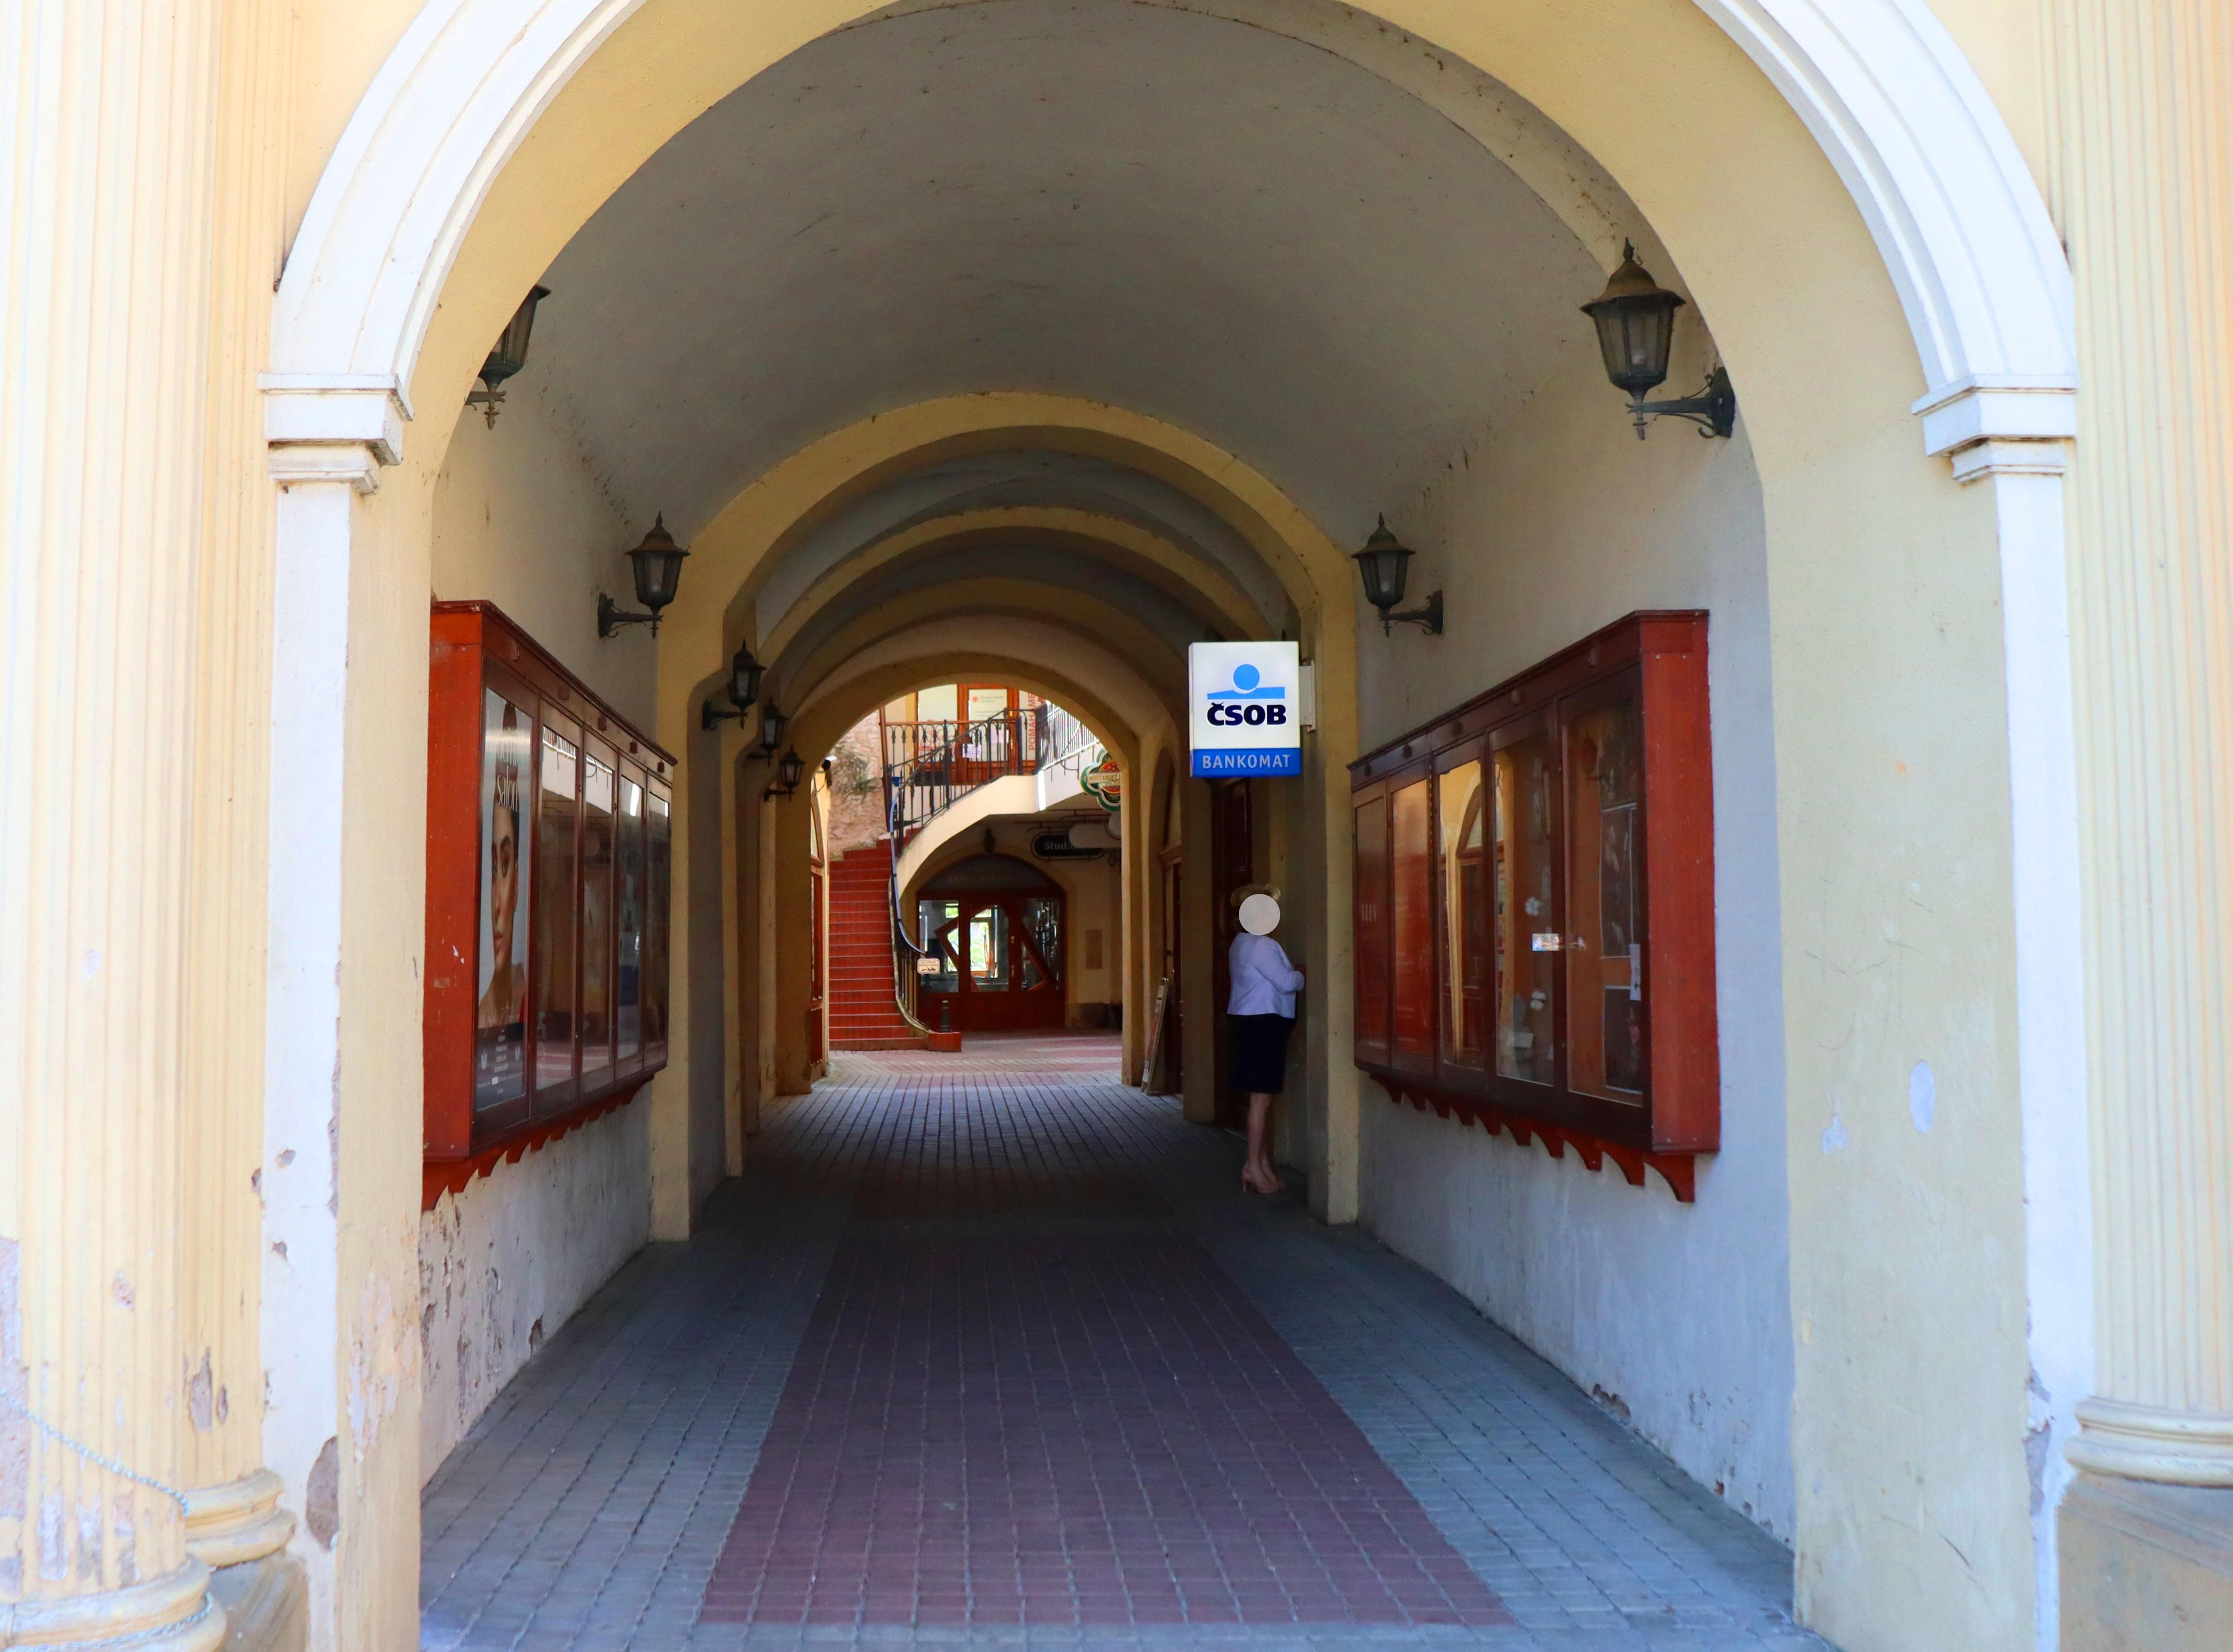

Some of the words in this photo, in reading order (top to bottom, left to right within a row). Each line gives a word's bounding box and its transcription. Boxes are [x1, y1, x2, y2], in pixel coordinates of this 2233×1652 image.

[1207, 702, 1287, 726] ČSOB
[1202, 754, 1291, 769] BANKOMAT
[497, 764, 519, 812] salon
